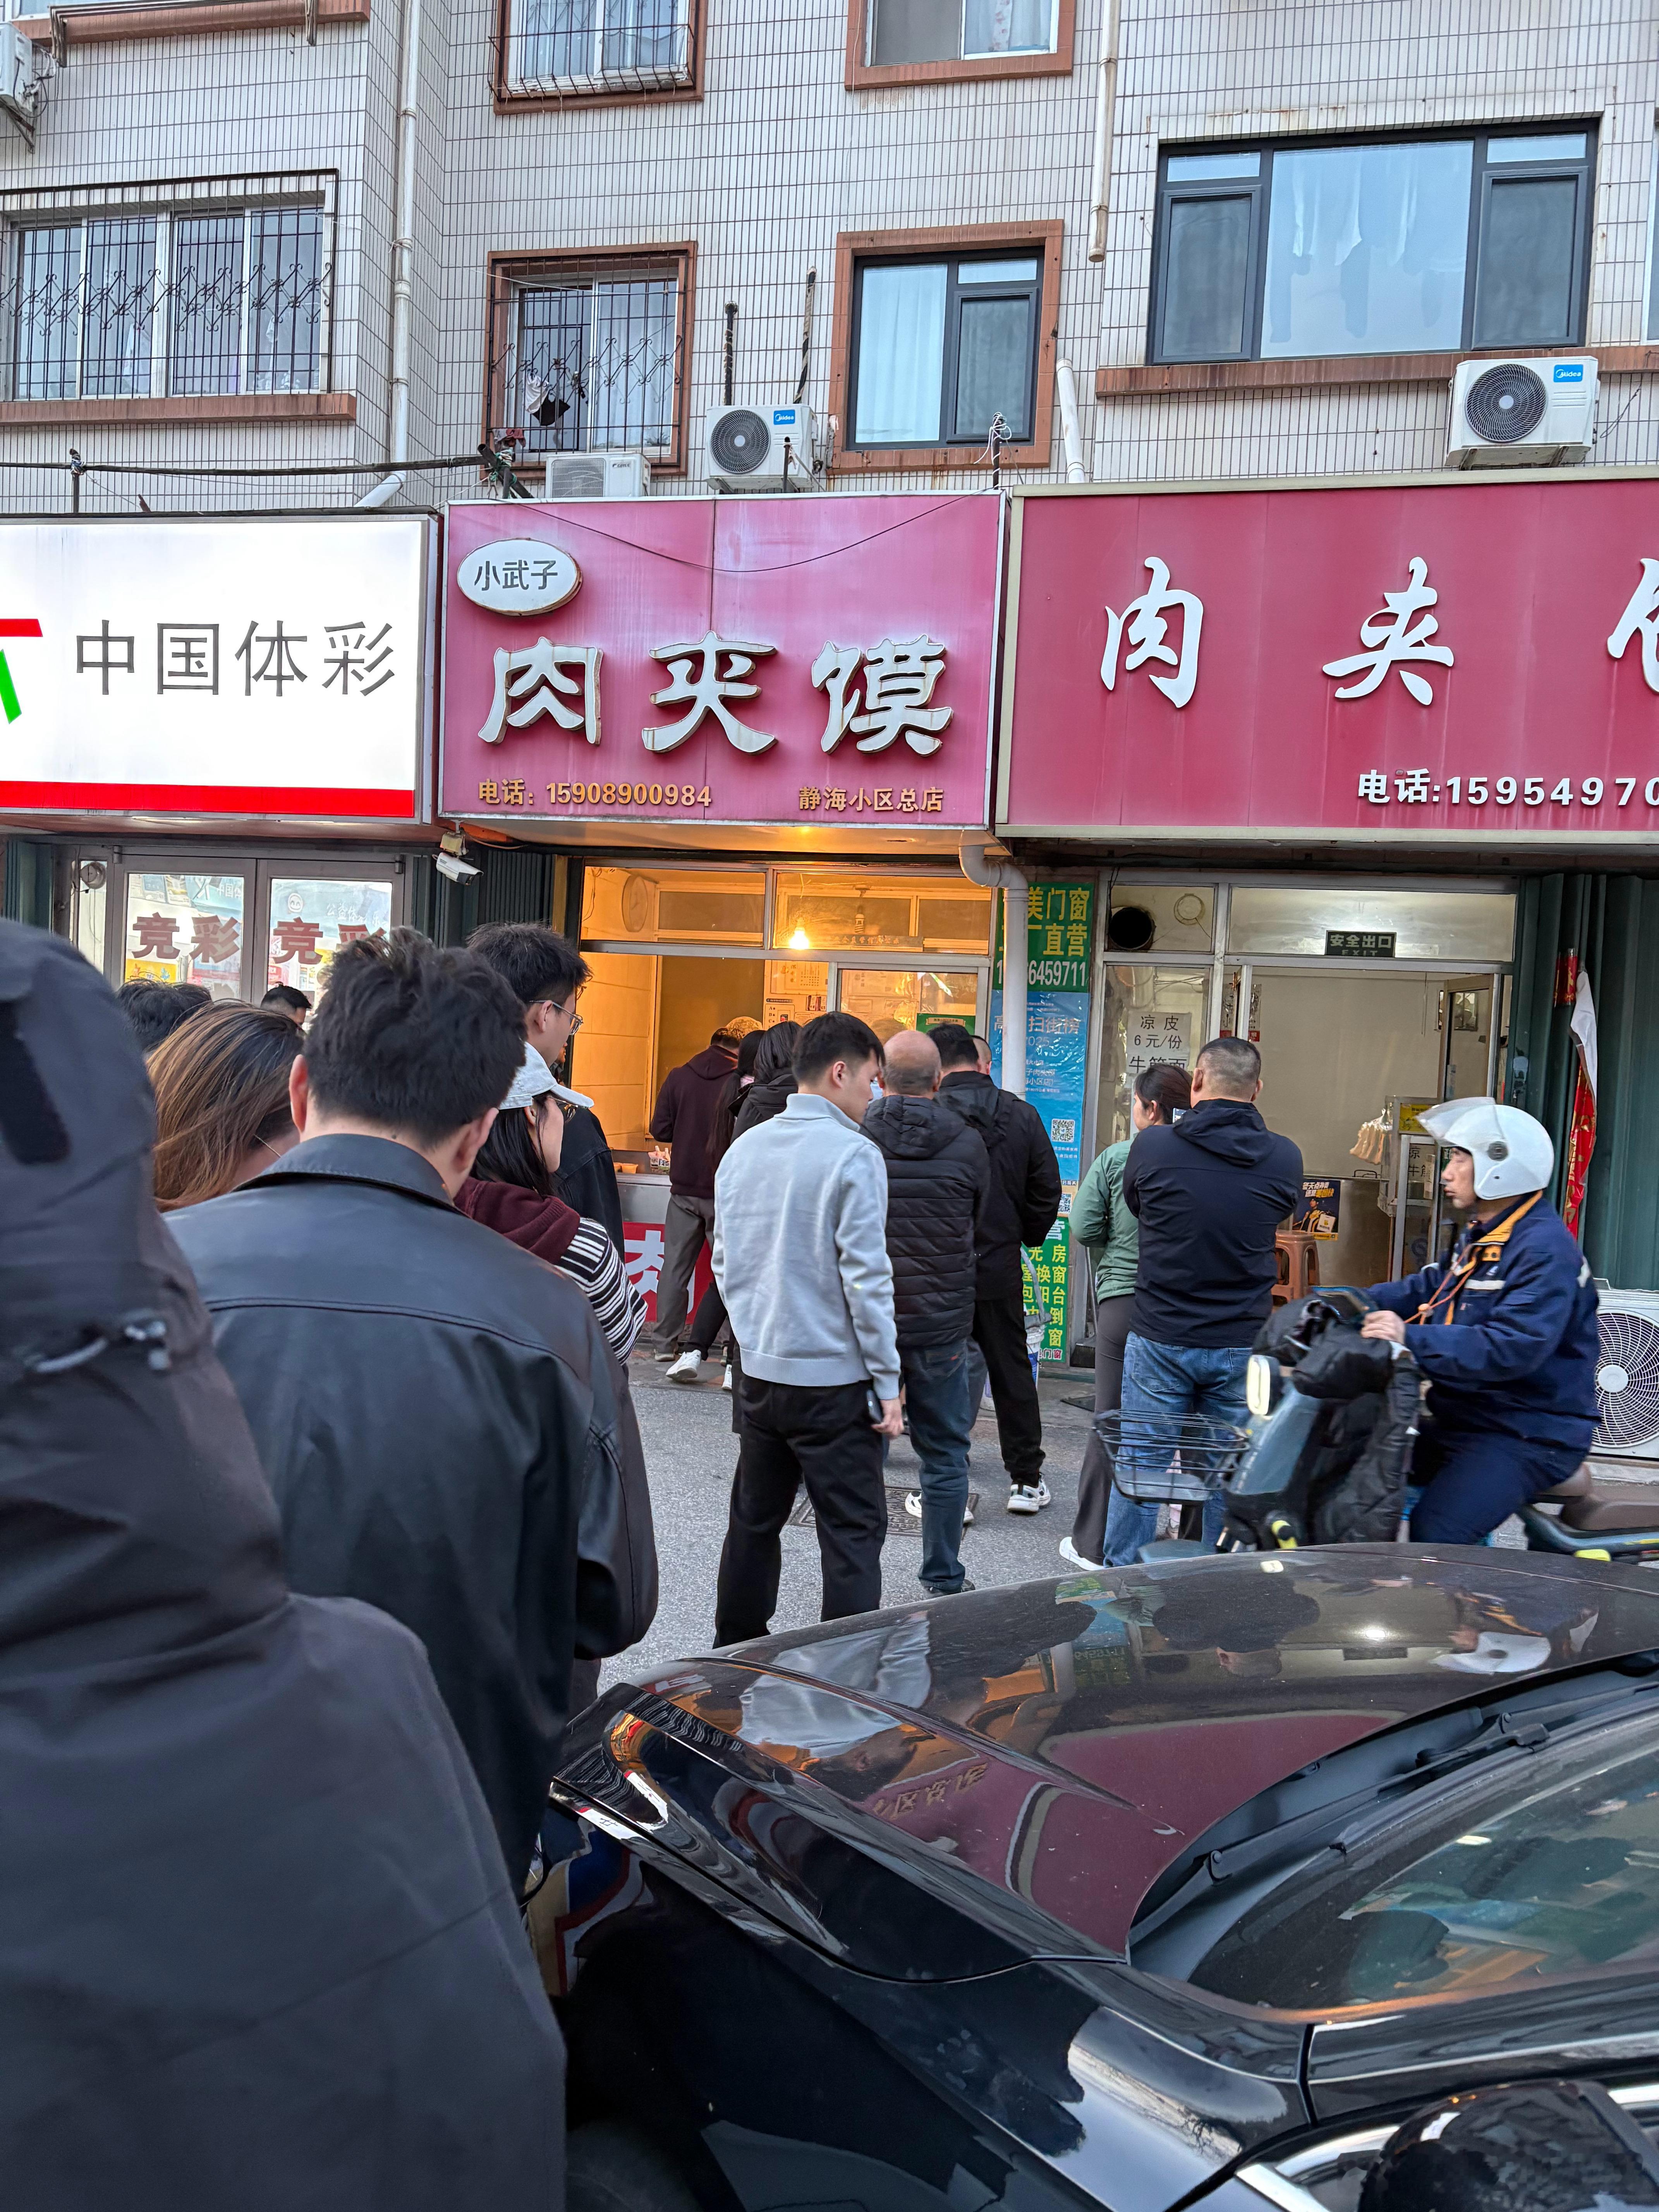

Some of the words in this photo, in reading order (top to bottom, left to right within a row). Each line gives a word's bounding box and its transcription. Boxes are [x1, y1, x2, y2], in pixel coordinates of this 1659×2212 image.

[1556, 369, 1582, 378] Midea
[775, 414, 794, 422] Midea
[474, 560, 559, 591] 小武子
[1101, 556, 1659, 708] 肉夹
[76, 620, 395, 697] 中国体彩
[478, 631, 954, 757] 肉夹馍
[799, 786, 945, 812] 静海小区总店
[1003, 887, 1089, 921] 美门窗
[132, 912, 240, 963] 竞彩
[1330, 934, 1392, 948] 安全出口
[997, 960, 1086, 987] 16459711
[994, 1015, 1080, 1035] 高扫街榜
[1140, 1014, 1179, 1031] 凉皮
[1026, 1036, 1049, 1047] 025
